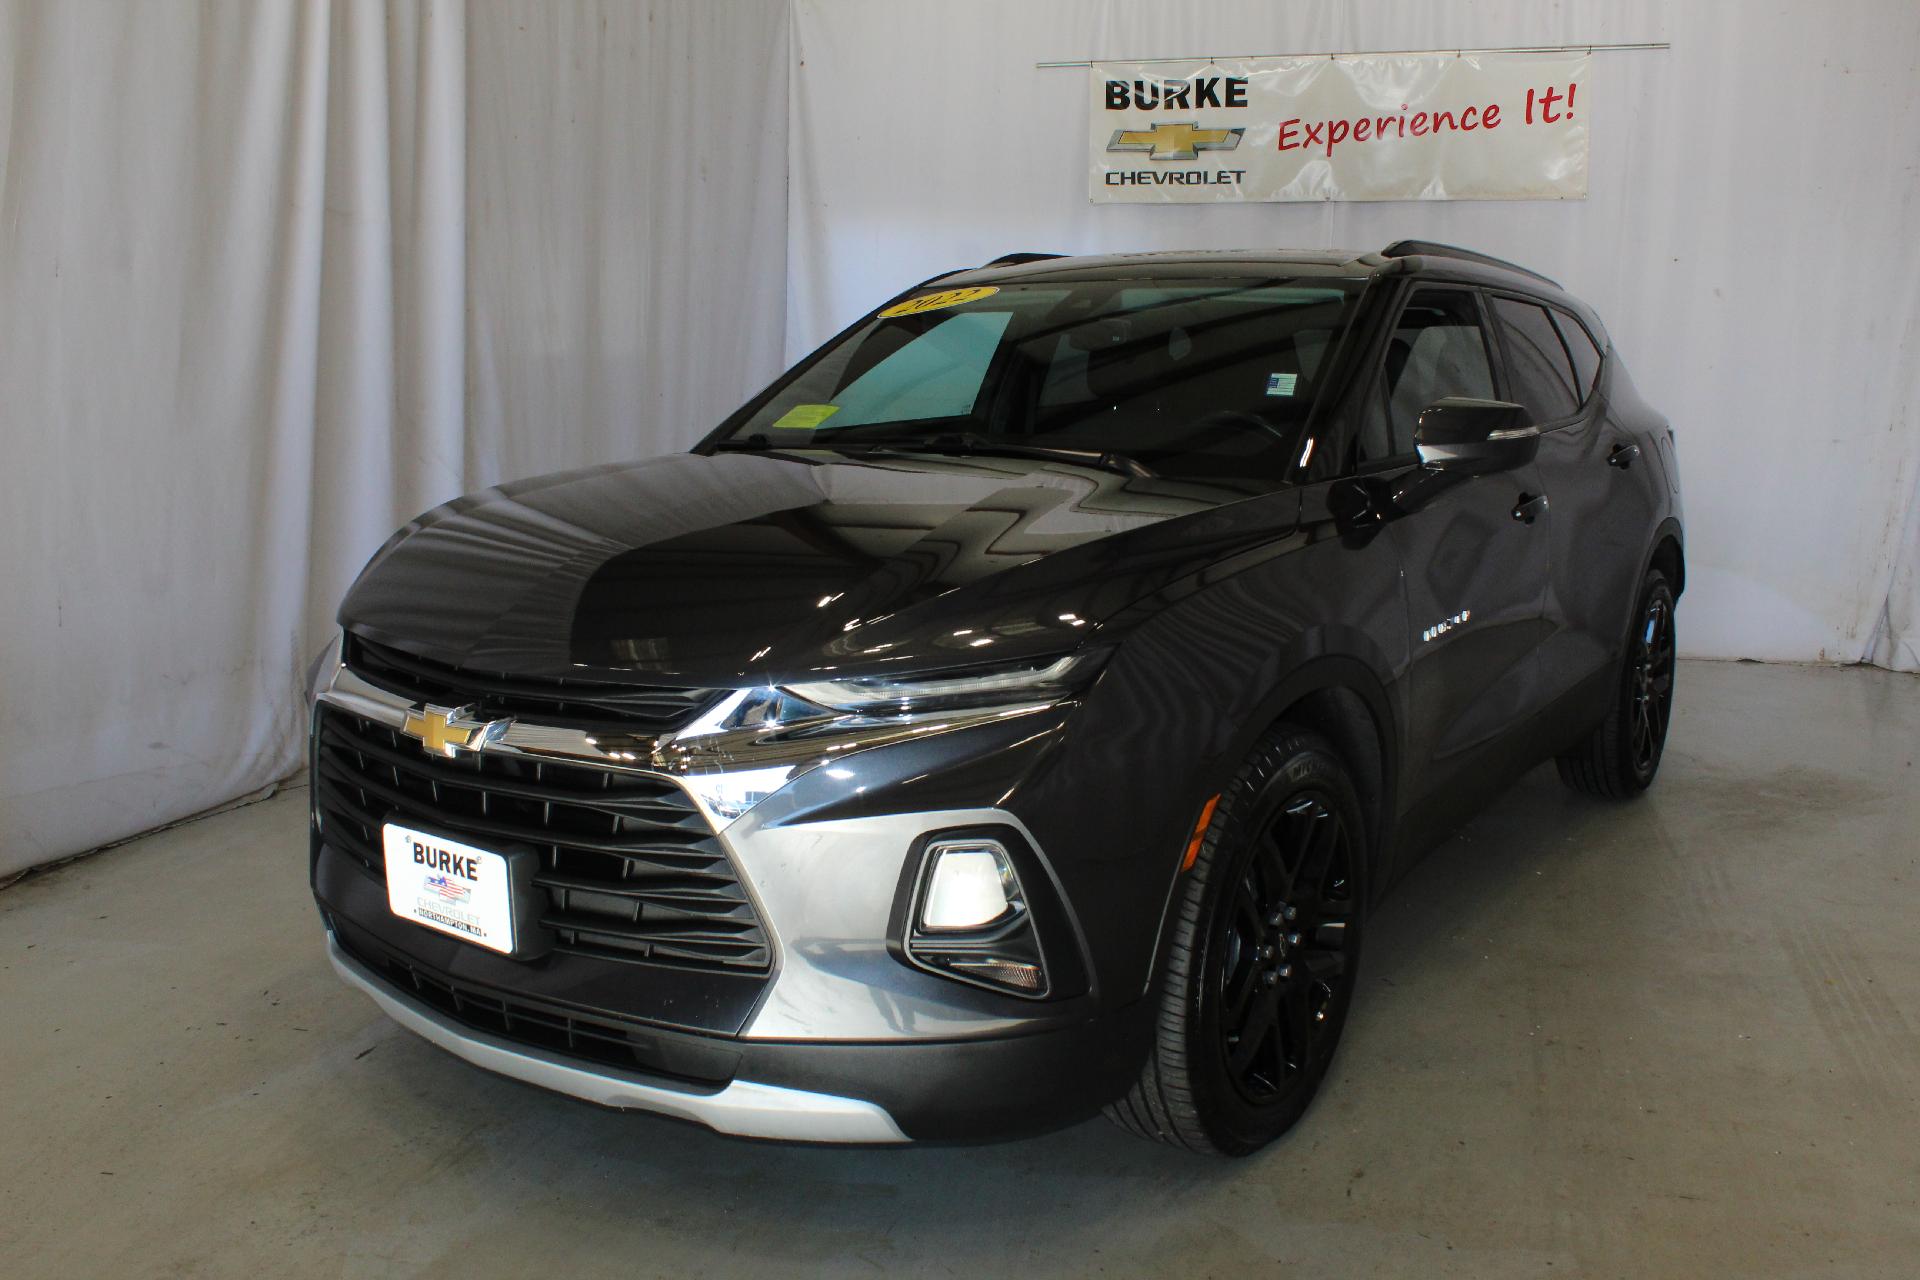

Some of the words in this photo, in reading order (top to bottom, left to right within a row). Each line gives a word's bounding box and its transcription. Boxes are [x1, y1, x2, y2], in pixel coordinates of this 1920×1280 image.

[1105, 77, 1249, 111] BURKE
[1278, 104, 1502, 157] Experience
[1524, 83, 1577, 126] It!
[1104, 170, 1247, 187] CHEVROLET
[413, 842, 478, 881] BURKE
[417, 897, 480, 925] CHEVROLET
